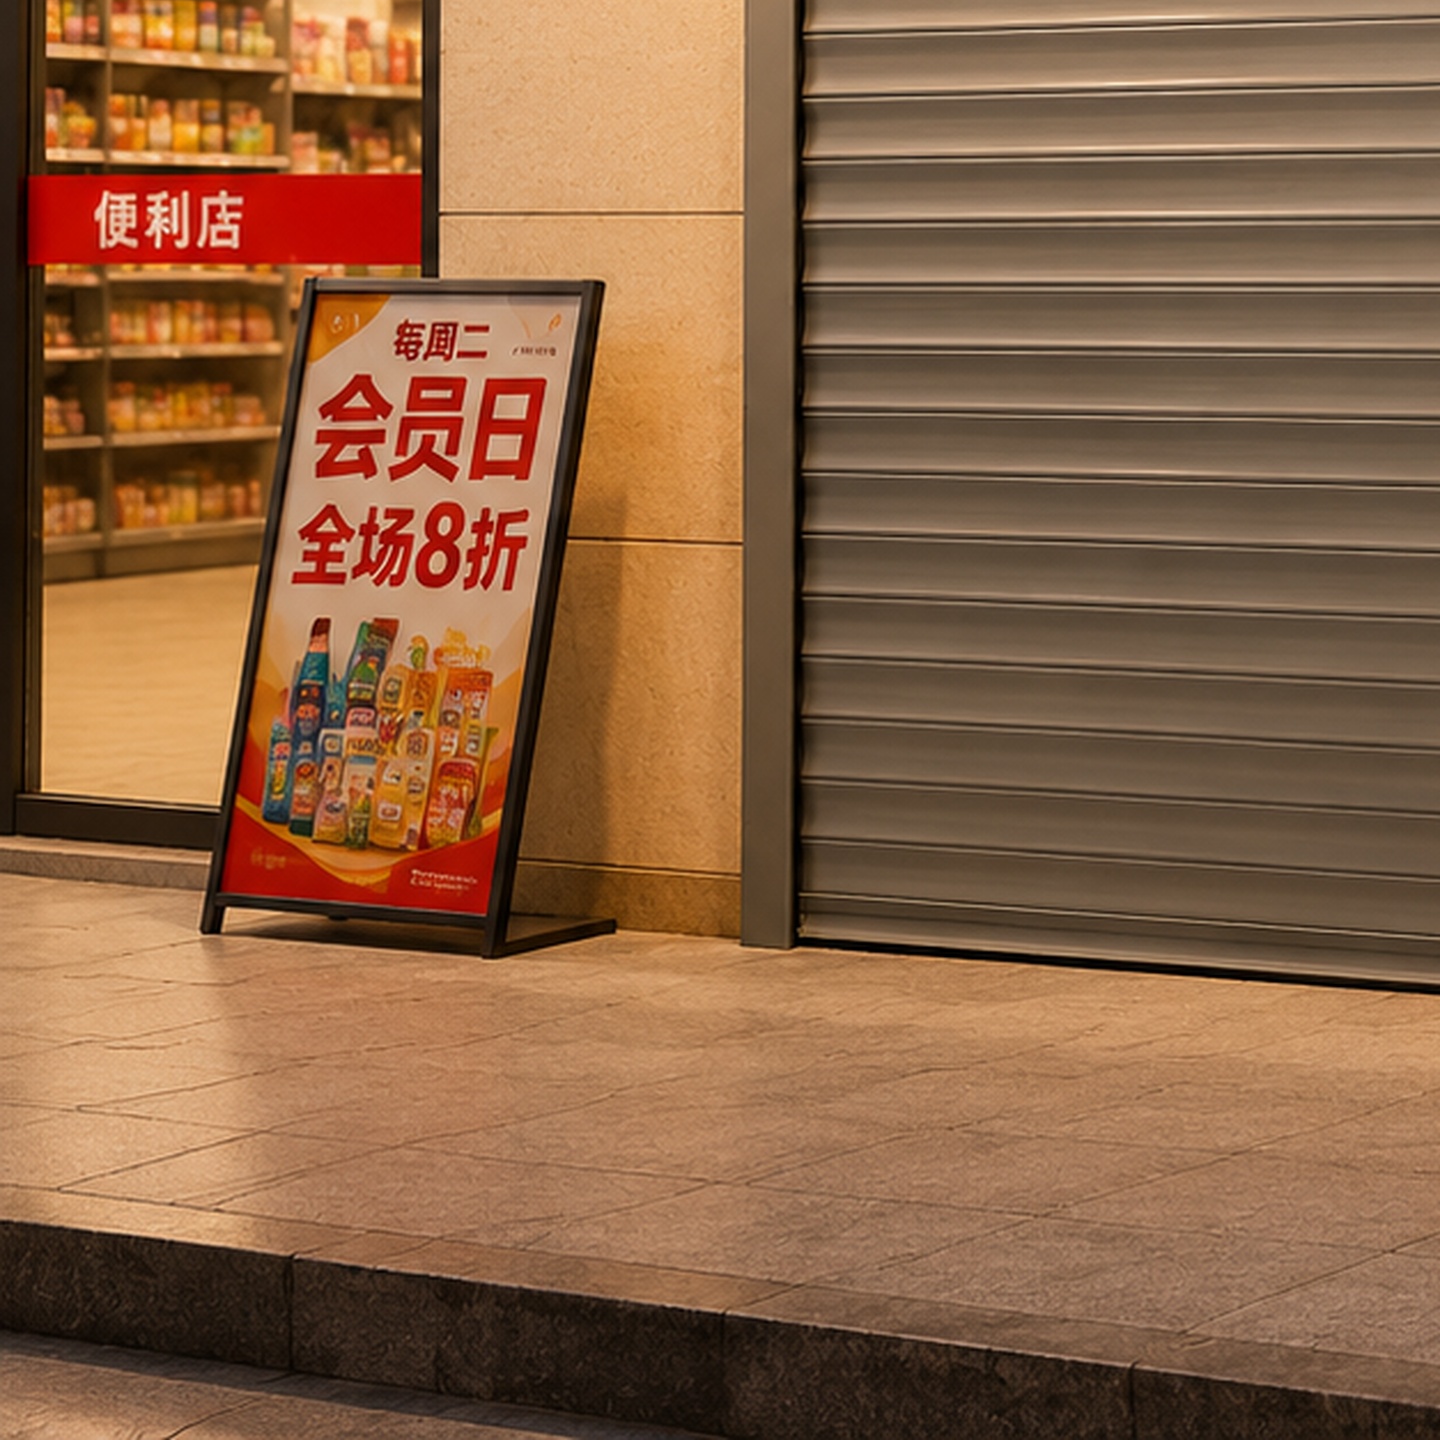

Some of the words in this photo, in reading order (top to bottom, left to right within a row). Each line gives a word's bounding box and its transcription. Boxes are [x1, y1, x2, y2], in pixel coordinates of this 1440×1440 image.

[94, 190, 243, 249] 便利店
[314, 373, 547, 483] 会员日
[291, 501, 530, 591] 全场8折
